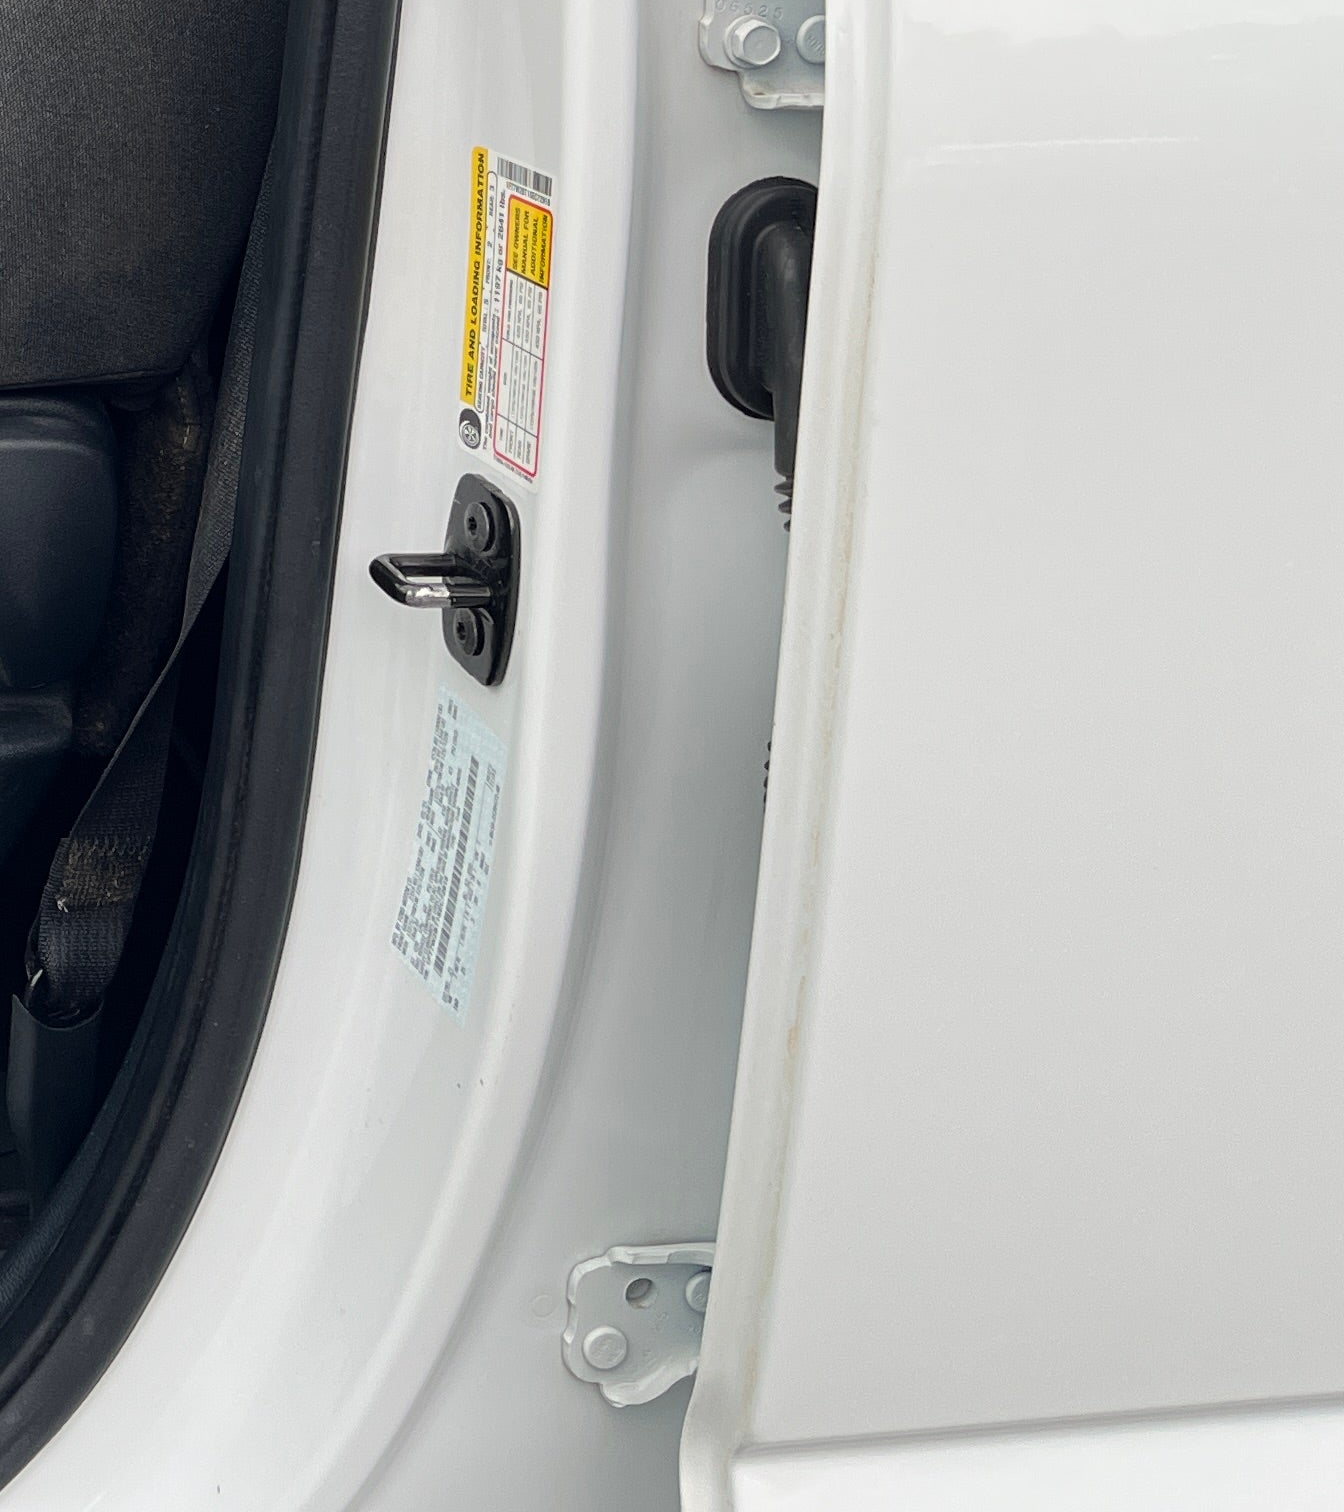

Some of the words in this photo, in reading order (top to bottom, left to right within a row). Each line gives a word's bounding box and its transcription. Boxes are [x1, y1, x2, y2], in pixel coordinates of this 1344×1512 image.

[475, 153, 485, 256] INFORMATION
[530, 216, 538, 276] ADDITIONAL
[538, 214, 548, 284] INFORMATION
[470, 261, 481, 325] LOADING
[467, 329, 477, 361] AND
[465, 362, 474, 397] TIRE
